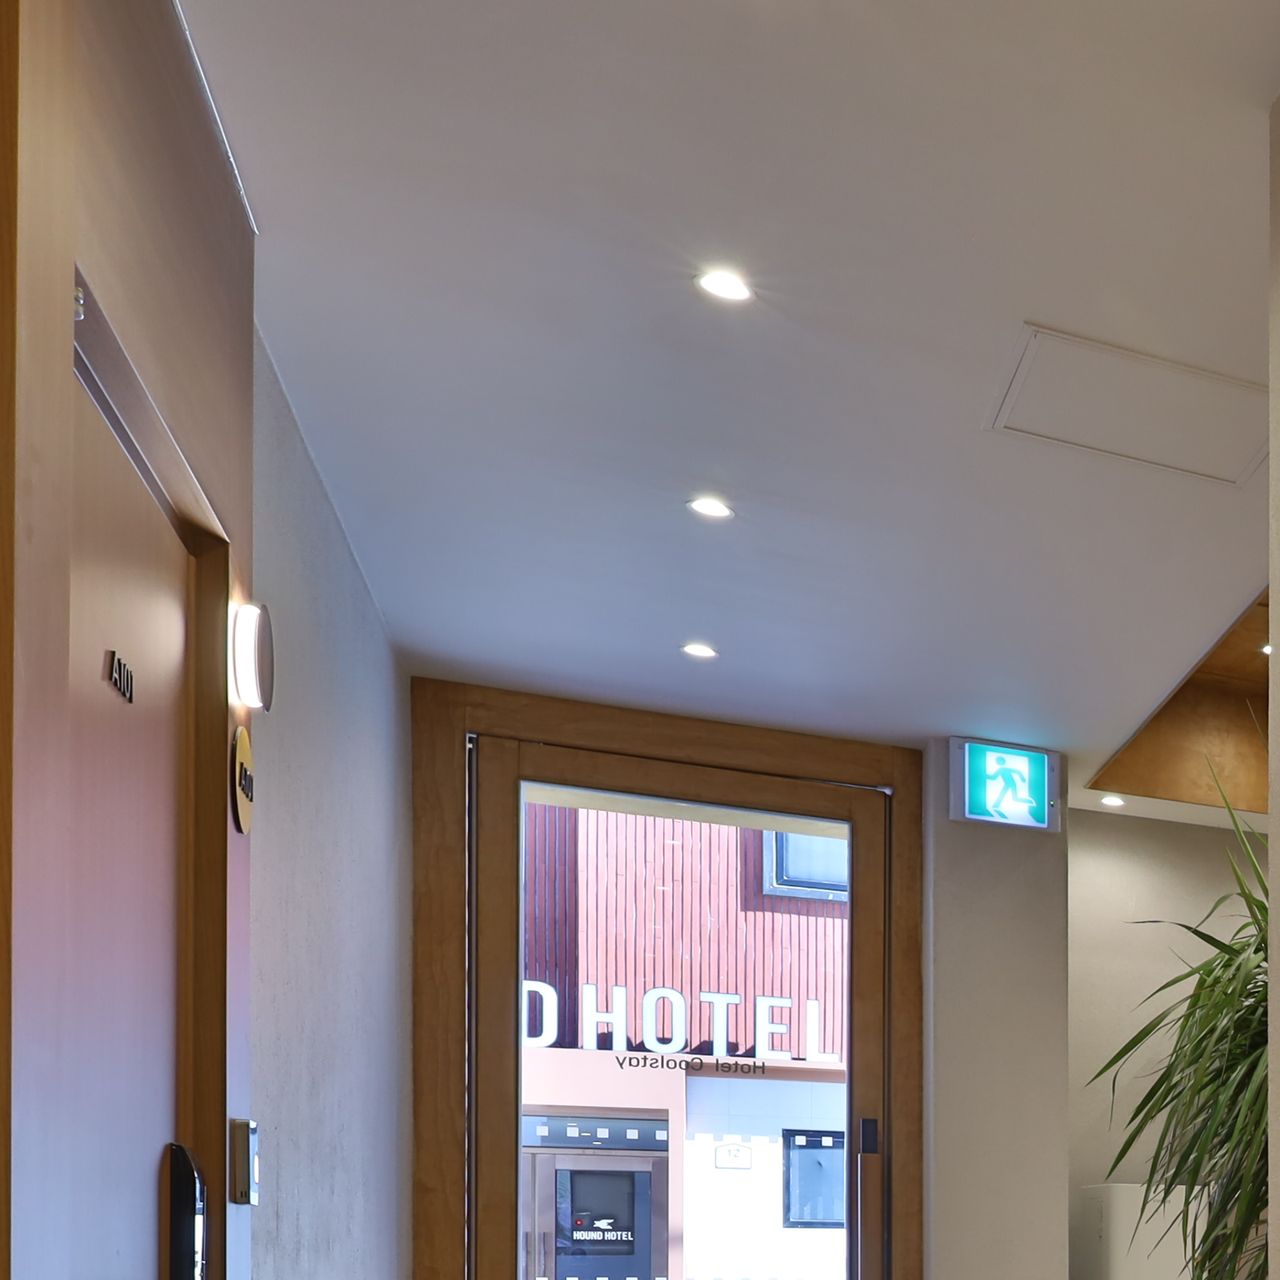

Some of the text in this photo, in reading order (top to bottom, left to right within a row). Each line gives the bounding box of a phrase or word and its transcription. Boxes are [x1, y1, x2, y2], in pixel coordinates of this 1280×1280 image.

[582, 983, 841, 1063] HOTEL
[573, 1230, 634, 1241] HOUND HOTEL
